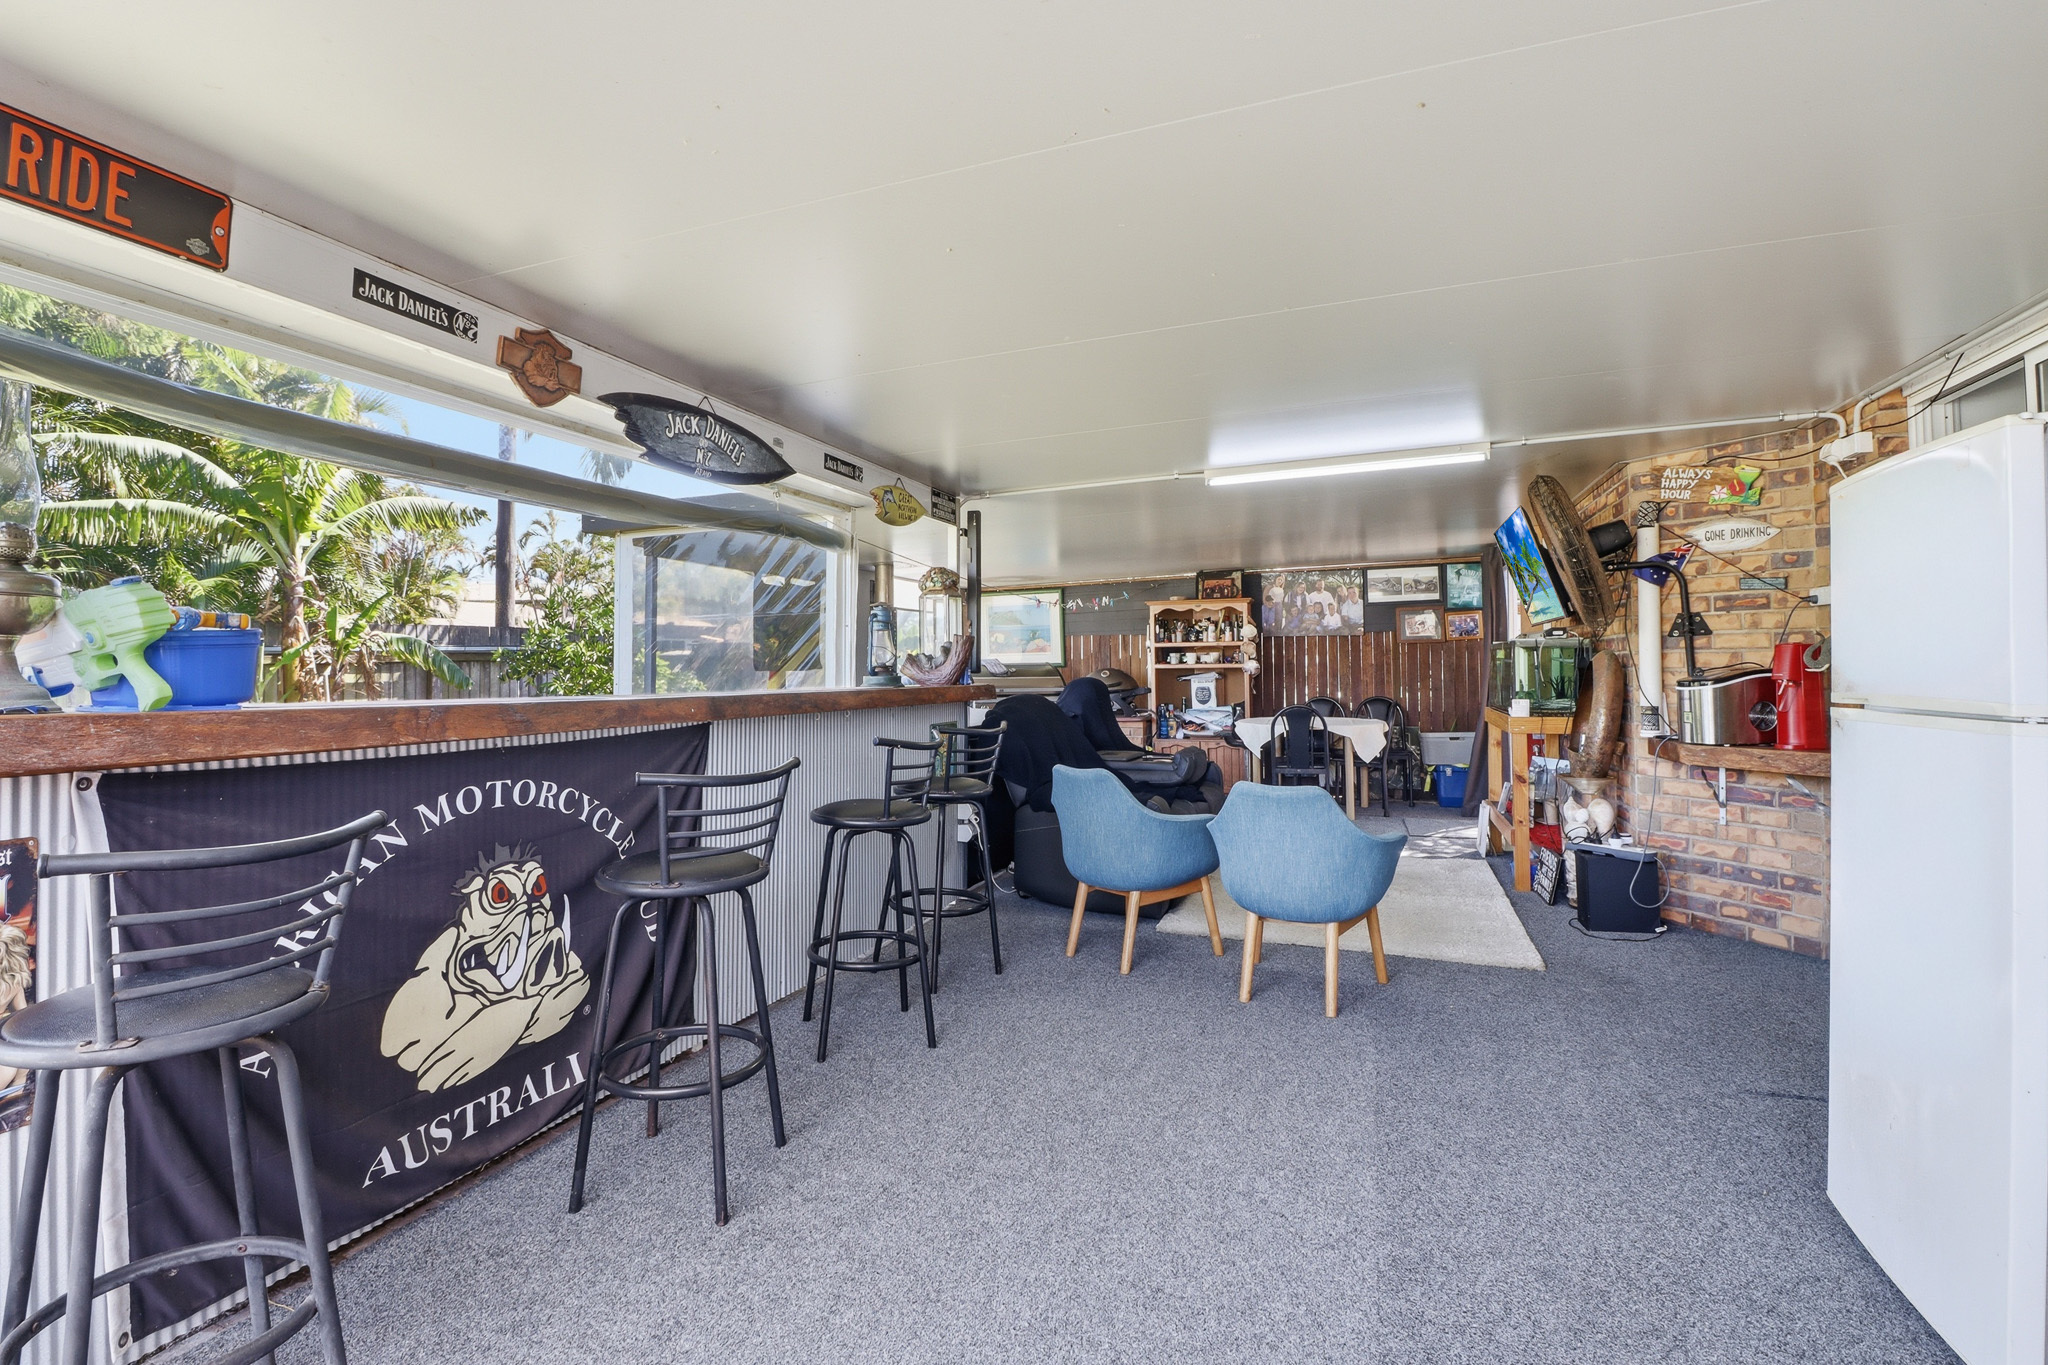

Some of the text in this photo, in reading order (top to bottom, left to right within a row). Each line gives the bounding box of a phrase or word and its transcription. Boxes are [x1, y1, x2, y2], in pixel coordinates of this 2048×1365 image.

[6, 121, 137, 229] RIDE
[358, 277, 449, 327] JACK DANIEL'S
[665, 413, 746, 467] JACK DANIEL'S
[825, 456, 837, 471] JACK
[1662, 467, 1713, 480] ALWAYS
[1660, 479, 1699, 489] HAPPY
[1660, 490, 1691, 500] HOUR
[1704, 526, 1771, 542] GONE DRINKING
[413, 779, 636, 860] MOTORCYCLE
[362, 1051, 587, 1188] AUSTRALI
